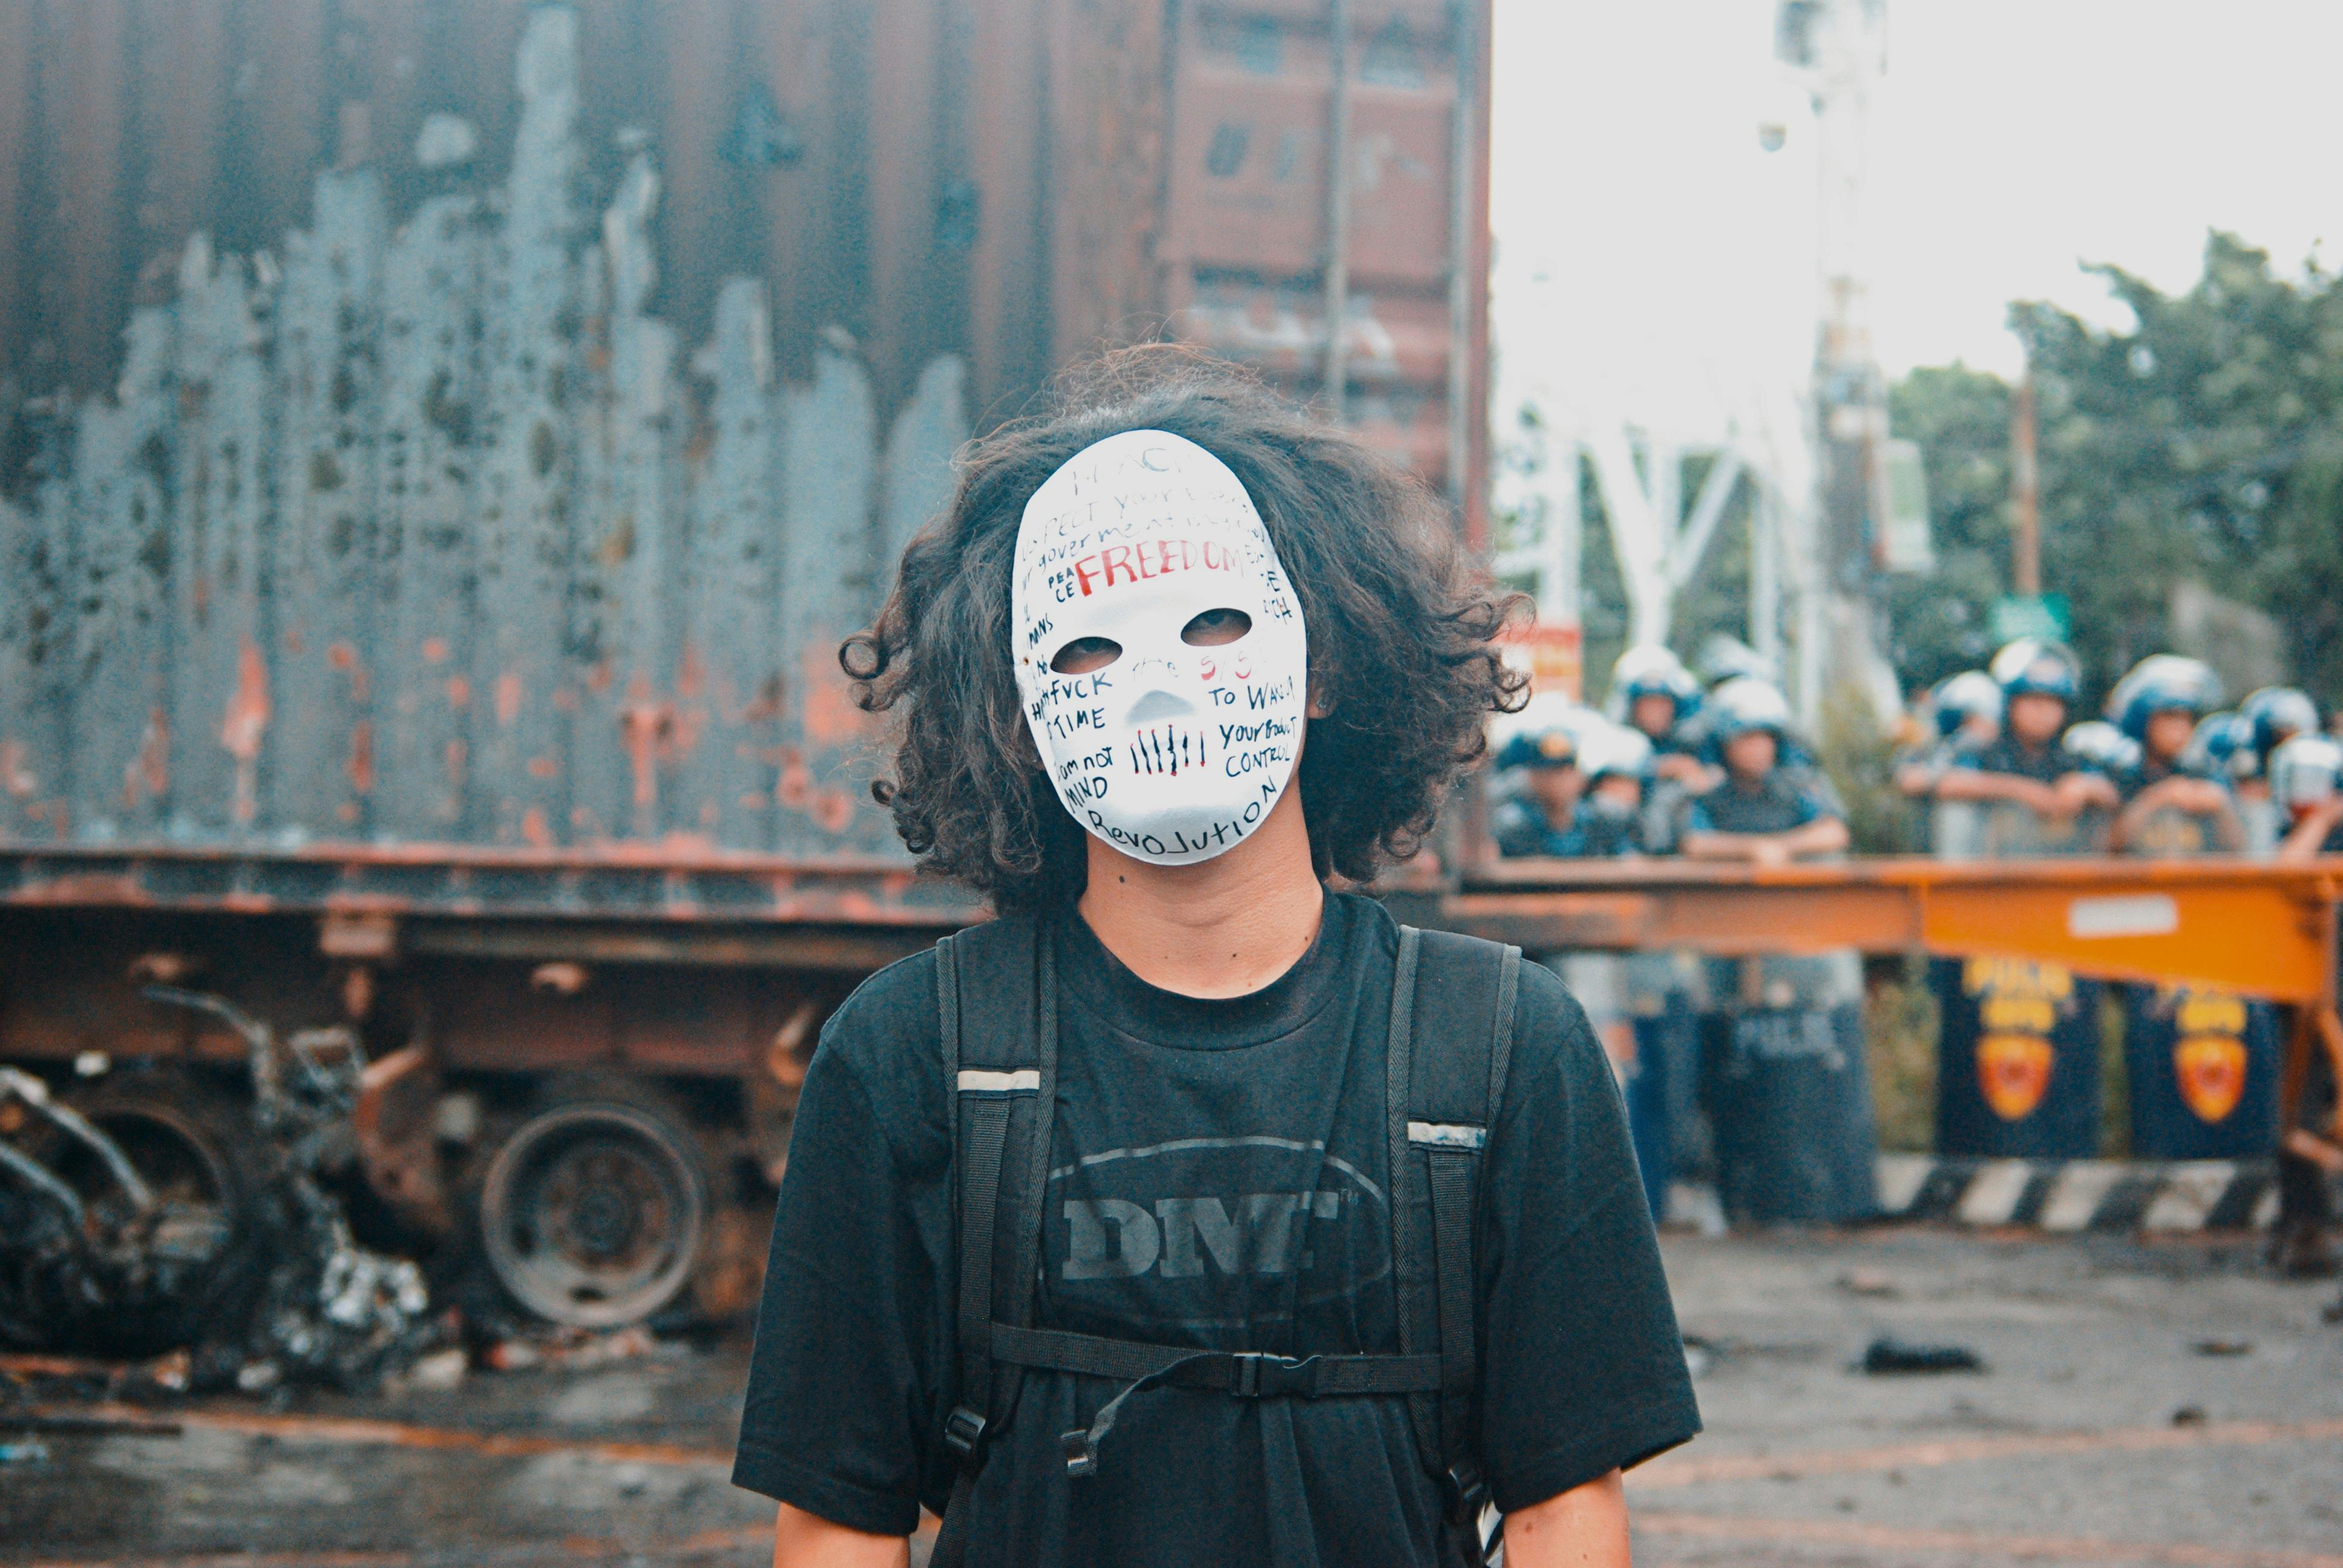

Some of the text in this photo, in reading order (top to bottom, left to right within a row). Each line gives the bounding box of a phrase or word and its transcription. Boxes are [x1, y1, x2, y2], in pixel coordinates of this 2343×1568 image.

[1075, 540, 1244, 597] FREEDOM
[1054, 707, 1106, 739] TIME
[1208, 687, 1236, 707] TO
[1064, 743, 1291, 814] MIND CONTROL
